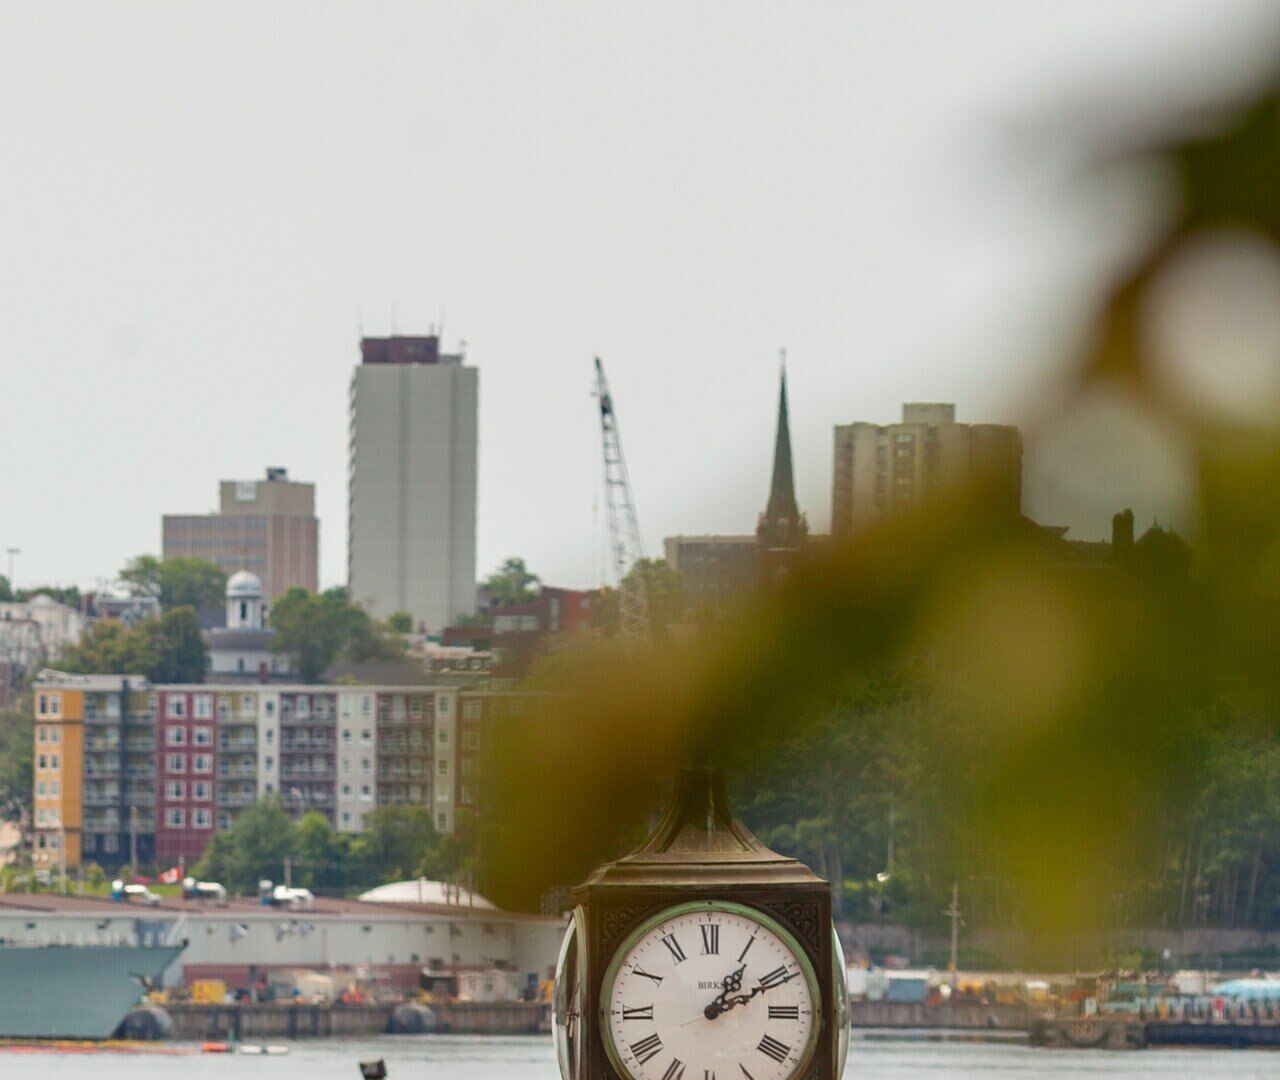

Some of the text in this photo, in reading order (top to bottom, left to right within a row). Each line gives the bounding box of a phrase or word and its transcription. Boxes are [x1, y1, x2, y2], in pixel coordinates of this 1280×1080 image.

[661, 933, 687, 966] XI
[699, 924, 720, 955] XII
[737, 935, 757, 963] I
[631, 963, 665, 988] X
[758, 965, 788, 986] II
[622, 1002, 654, 1022] IX
[768, 1003, 799, 1021] III
[629, 1031, 664, 1066] VIII
